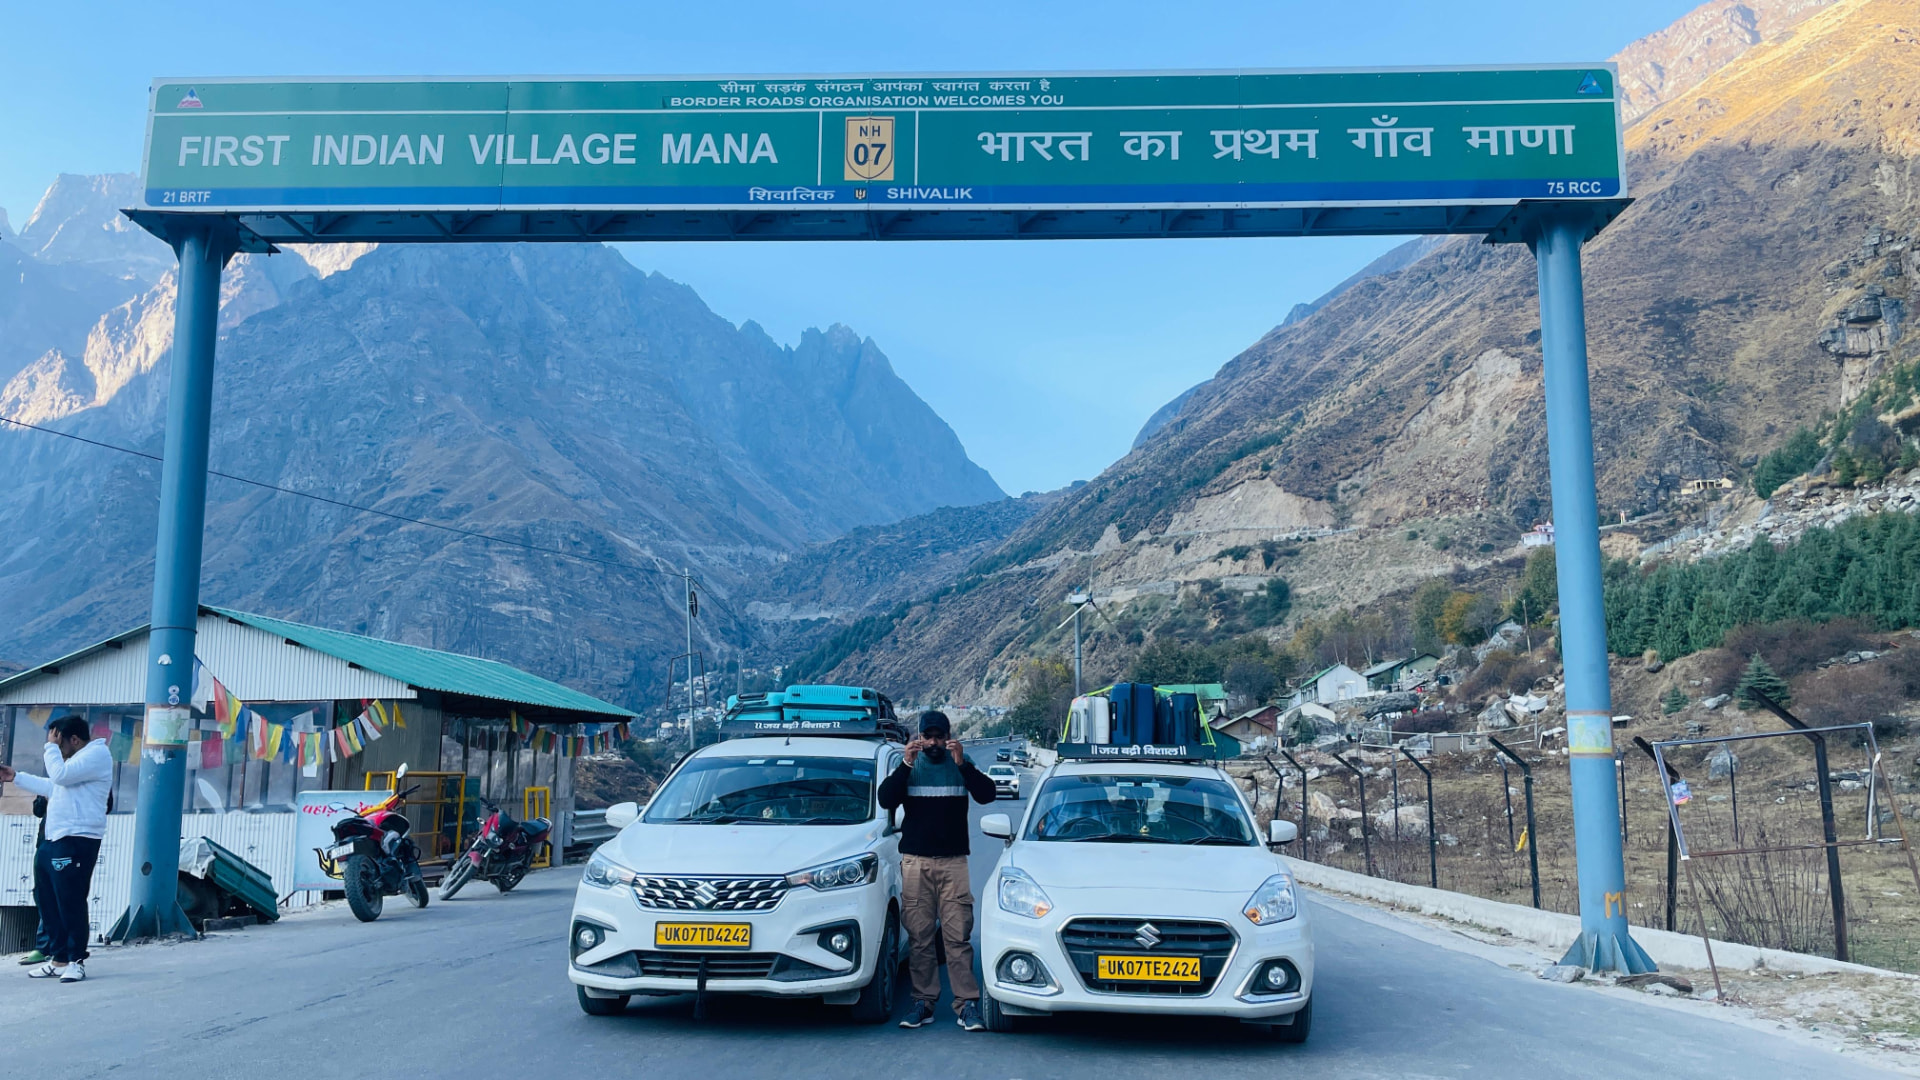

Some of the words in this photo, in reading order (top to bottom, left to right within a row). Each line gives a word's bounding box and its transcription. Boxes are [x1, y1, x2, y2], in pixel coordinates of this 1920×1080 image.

[719, 81, 755, 93] सीमा
[764, 81, 806, 94] सड़क
[815, 80, 864, 93] संगठन
[873, 81, 922, 92] आपका
[932, 81, 980, 92] स्वागत
[989, 80, 1030, 92] करता
[1039, 78, 1051, 92] है
[670, 97, 740, 107] BORDER
[746, 96, 804, 107] ROADS
[809, 95, 928, 107] ORGANISATION
[933, 95, 1026, 106] WELCOMES
[1030, 94, 1064, 106] YOU
[859, 125, 881, 137] NH
[977, 131, 1093, 161] भारत
[1119, 130, 1183, 161] का
[1210, 128, 1320, 160] प्रथम
[1347, 114, 1434, 158] गाँव
[1462, 125, 1576, 156] माणा
[178, 135, 290, 167] FIRST
[312, 134, 444, 166] INDIAN
[468, 133, 636, 165] VILLAGE
[661, 132, 778, 164] MANA
[853, 143, 887, 166] 07
[748, 186, 836, 201] शिवालिक
[887, 187, 973, 200] SHIVALIK
[1547, 181, 1565, 194] 75
[1569, 181, 1602, 194] RCC
[163, 191, 176, 203] 21
[179, 191, 211, 203] BRTF
[665, 927, 749, 943] UK07TD4242
[1108, 960, 1199, 977] UK07TE2424
